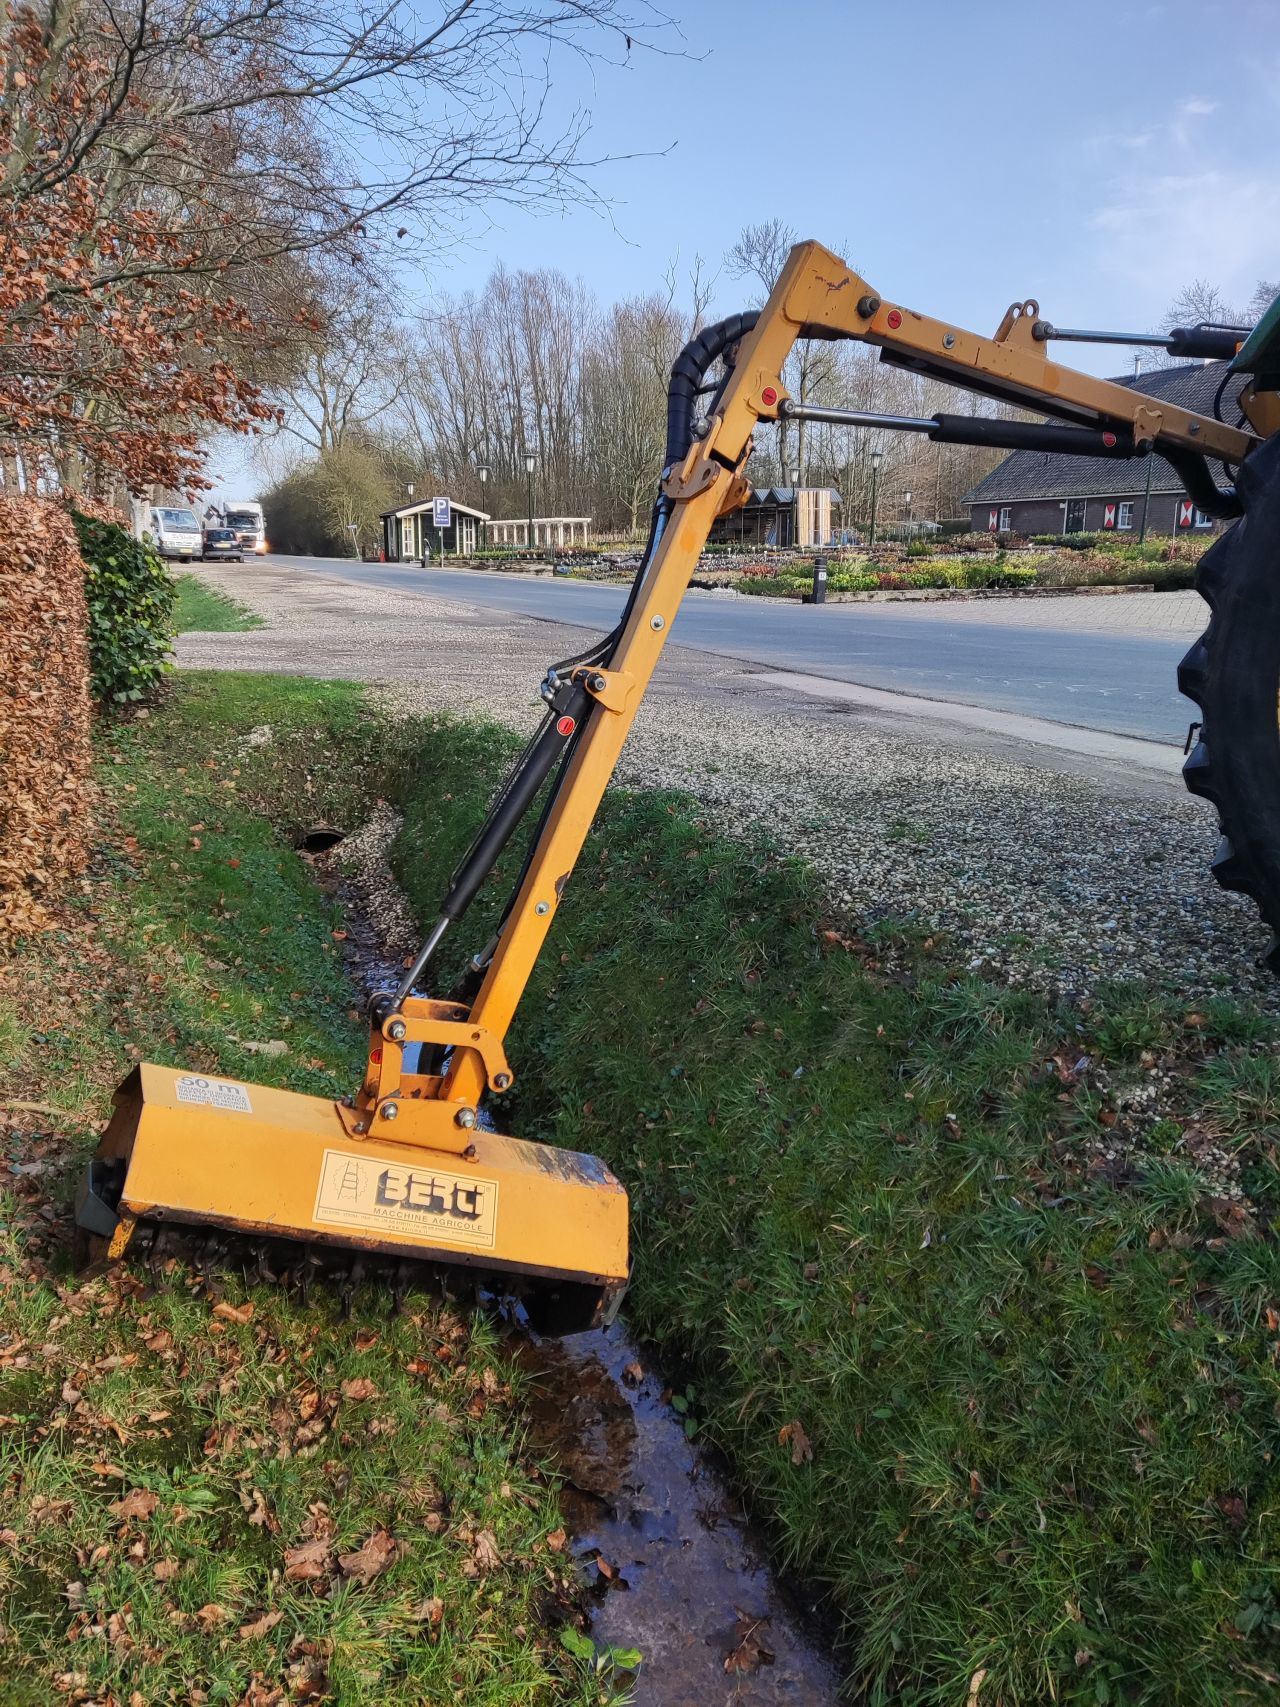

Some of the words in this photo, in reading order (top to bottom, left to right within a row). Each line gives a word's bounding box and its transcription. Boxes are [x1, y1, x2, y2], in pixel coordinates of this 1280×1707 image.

[436, 499, 447, 514] P
[180, 1076, 209, 1089] 50
[217, 1084, 240, 1095] m
[373, 1207, 429, 1223] MACCHINE
[432, 1217, 483, 1232] AGRICOLE
